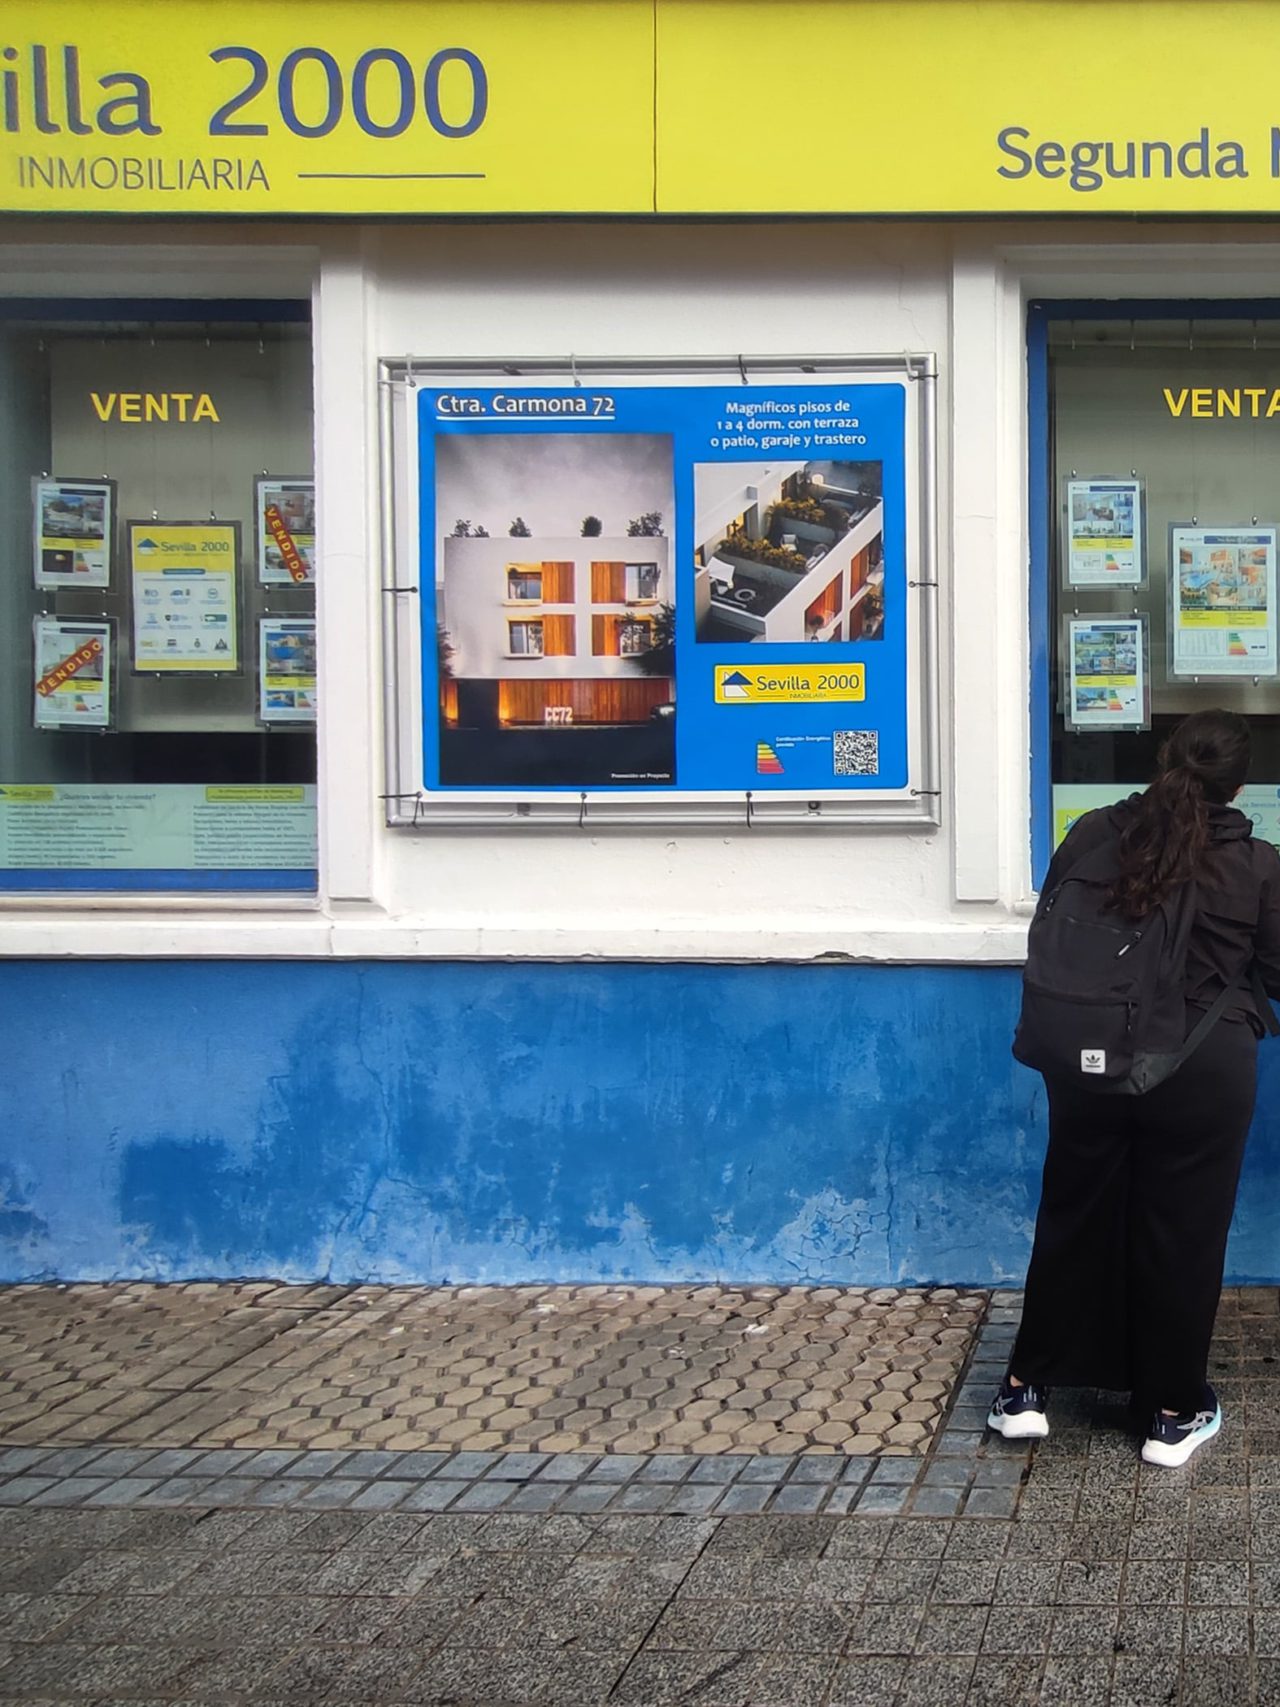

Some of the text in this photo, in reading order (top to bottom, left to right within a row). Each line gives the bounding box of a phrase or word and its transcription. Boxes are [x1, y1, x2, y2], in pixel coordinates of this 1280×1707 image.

[2, 45, 489, 138] illa 2000
[997, 126, 1248, 192] Segunda
[18, 156, 271, 192] INMOBILIARIA
[91, 393, 221, 422] VENTA
[437, 395, 616, 416] Ctra. Carmona 72
[726, 400, 850, 416] Magníficos pisos de
[717, 417, 859, 432] 1 a 4 dorm. con terraza
[710, 432, 867, 450] o patio, garaje y trastero
[161, 541, 230, 552] Sevilla 2000
[266, 507, 306, 583] VENDIDO
[37, 640, 101, 696] VENDIDO
[757, 674, 860, 691] Sevilla 2000
[544, 706, 573, 721] CC72
